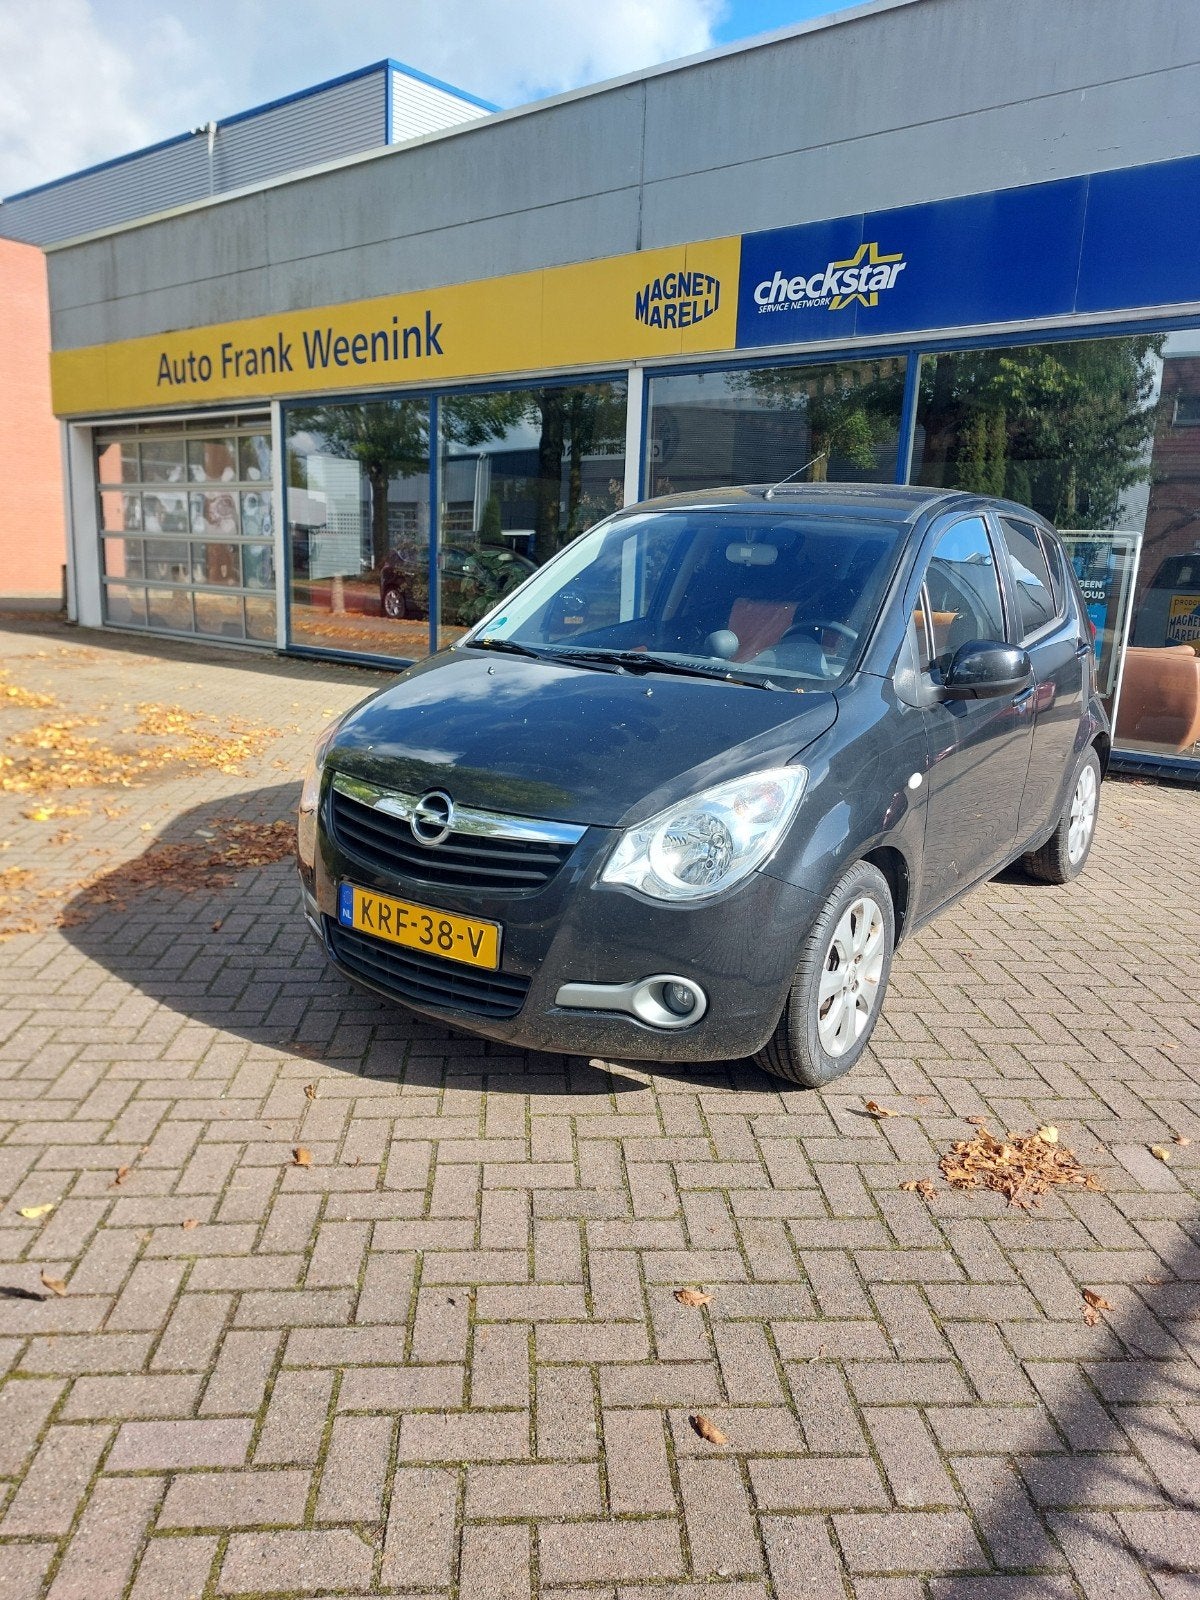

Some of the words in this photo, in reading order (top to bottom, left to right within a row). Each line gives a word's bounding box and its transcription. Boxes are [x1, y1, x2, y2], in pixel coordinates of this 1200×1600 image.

[635, 271, 721, 318] MAGNETI
[754, 261, 907, 305] checkstar
[634, 290, 720, 329] MARELLI
[758, 302, 789, 314] SERVICE
[790, 297, 832, 310] NETWORK
[157, 351, 212, 387] Auto
[221, 332, 293, 379] Frank
[303, 310, 444, 370] Weenink
[1081, 591, 1106, 599] OUD
[342, 908, 352, 919] NL
[361, 897, 485, 958] KRF-38-V
